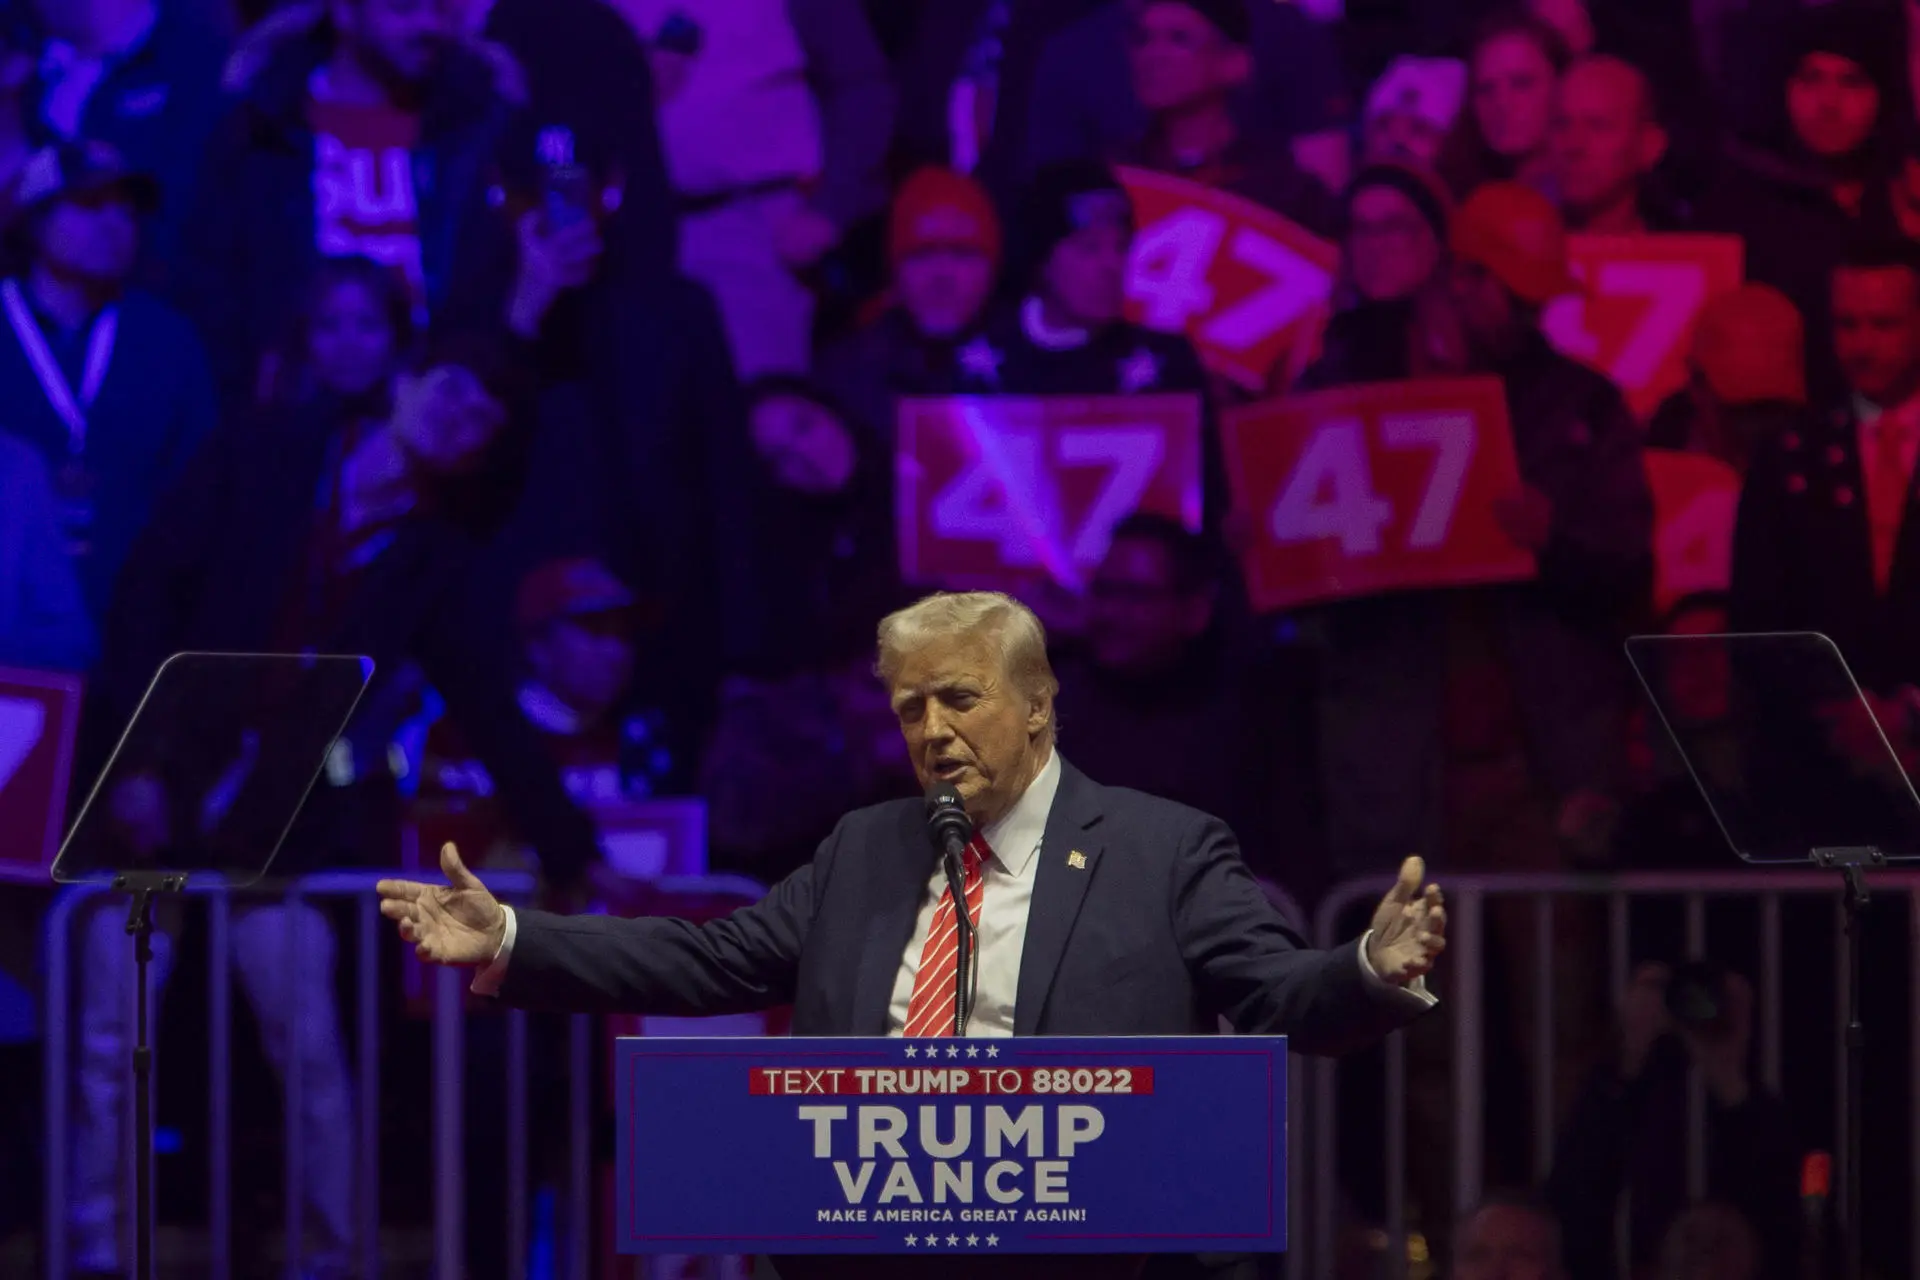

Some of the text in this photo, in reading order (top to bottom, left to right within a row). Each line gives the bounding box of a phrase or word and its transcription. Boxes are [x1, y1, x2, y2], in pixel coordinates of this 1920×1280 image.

[1127, 208, 1332, 346] 47
[933, 428, 1162, 565] 47
[1268, 412, 1476, 556] 47
[762, 1068, 1132, 1093] TEXT TRUMP TO 88022
[798, 1104, 1105, 1158] TRUMP
[832, 1160, 1070, 1203] VANCE
[817, 1208, 1086, 1222] MAKE AMERICA GREAT AGAIN!
